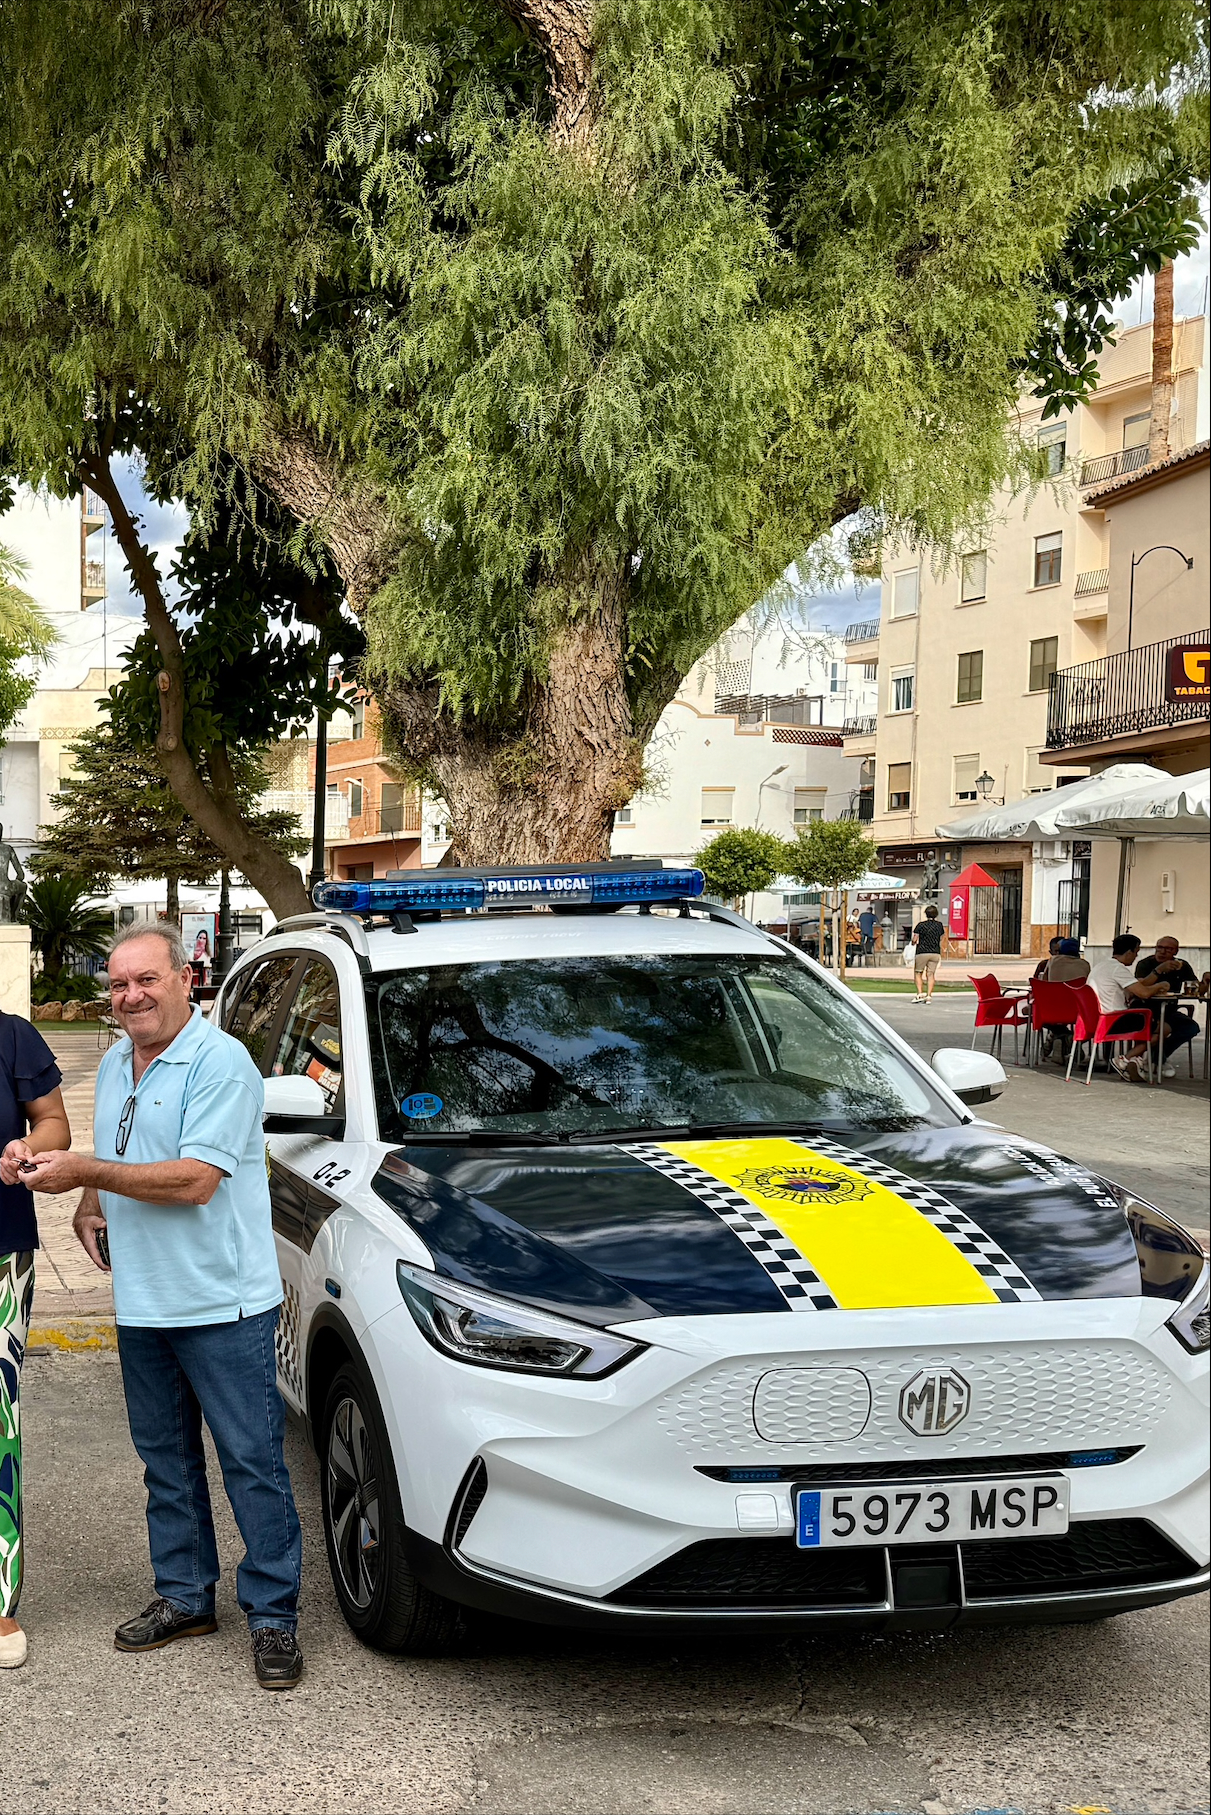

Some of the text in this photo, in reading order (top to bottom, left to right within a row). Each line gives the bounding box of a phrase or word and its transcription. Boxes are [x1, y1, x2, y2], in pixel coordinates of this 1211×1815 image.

[488, 878, 589, 892] POLICIA LOCAL
[1071, 1178, 1106, 1195] PUIG
[1093, 1196, 1119, 1208] EL
[907, 1375, 964, 1431] MG
[805, 1486, 1058, 1537] E 5973 MSP
